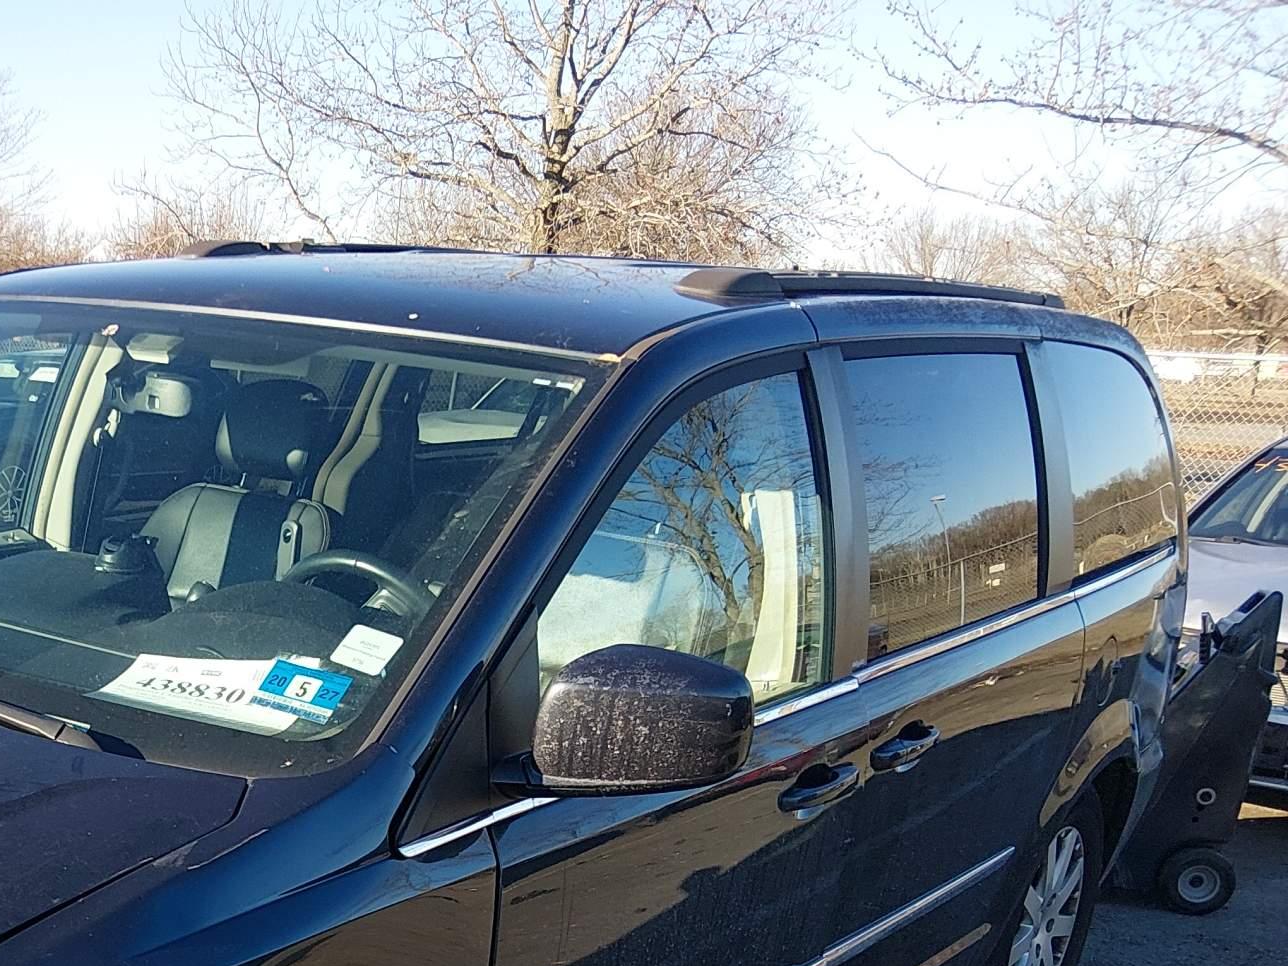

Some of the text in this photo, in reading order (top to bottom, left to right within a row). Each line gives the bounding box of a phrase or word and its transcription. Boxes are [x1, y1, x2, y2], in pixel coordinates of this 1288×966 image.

[135, 677, 251, 706] 438830
[267, 674, 288, 688] 20
[295, 681, 313, 698] 5
[317, 688, 340, 701] 27
